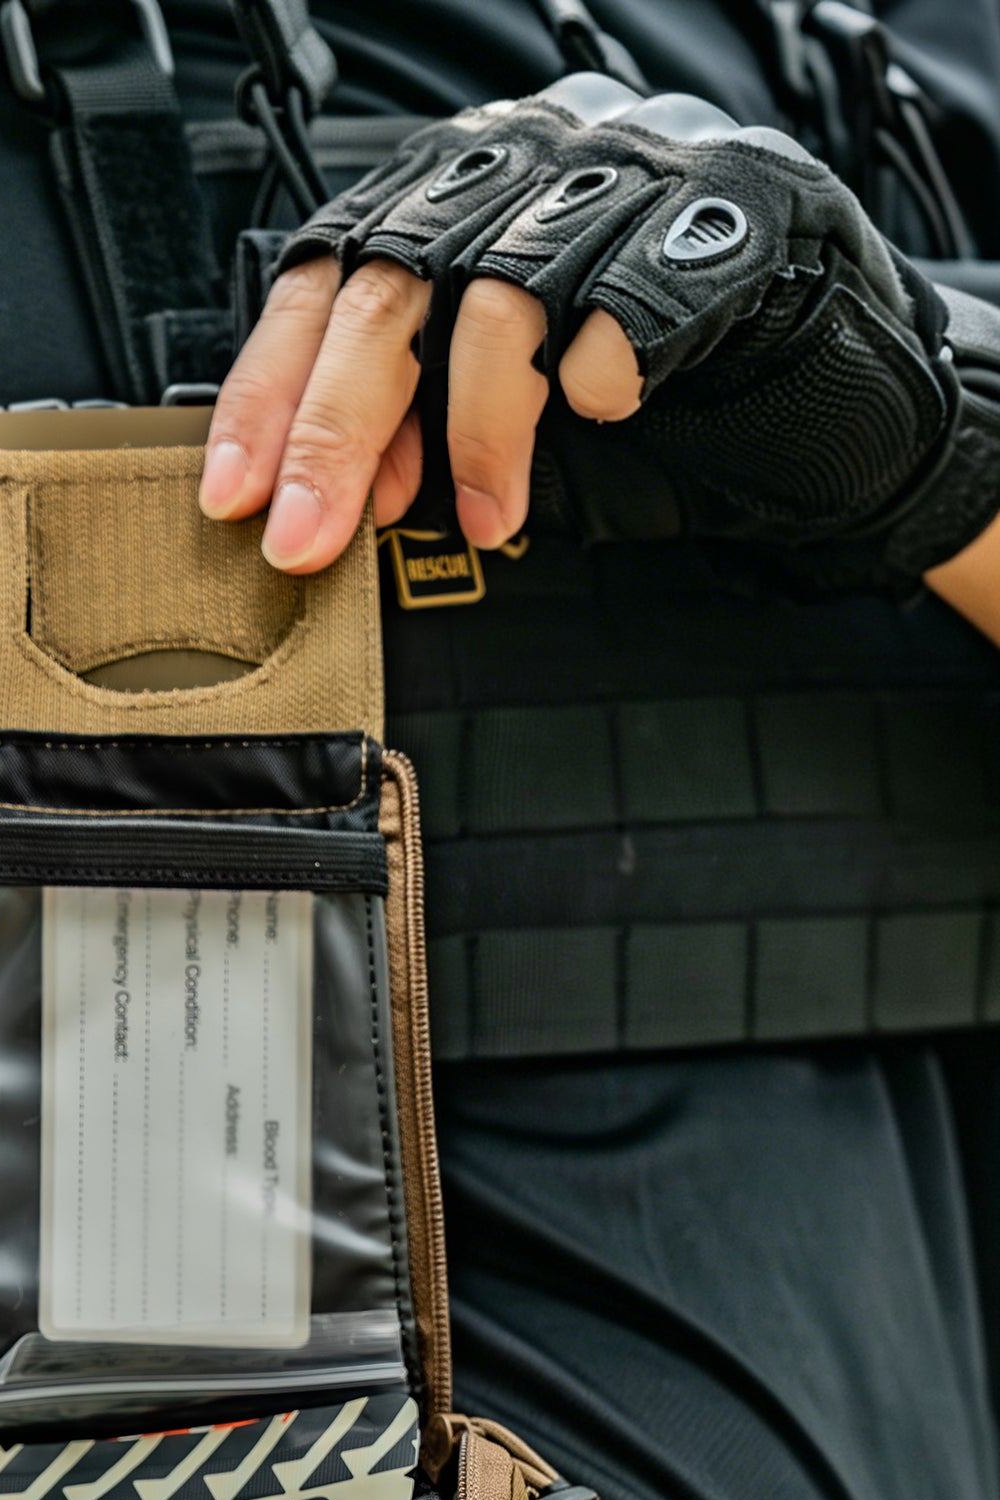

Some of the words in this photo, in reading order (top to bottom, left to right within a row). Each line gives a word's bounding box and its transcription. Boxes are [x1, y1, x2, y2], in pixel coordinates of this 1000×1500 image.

[406, 553, 470, 582] RESCUE
[112, 891, 132, 988] Emergency
[184, 963, 201, 1051] Condition:
[264, 1120, 279, 1170] Blood
